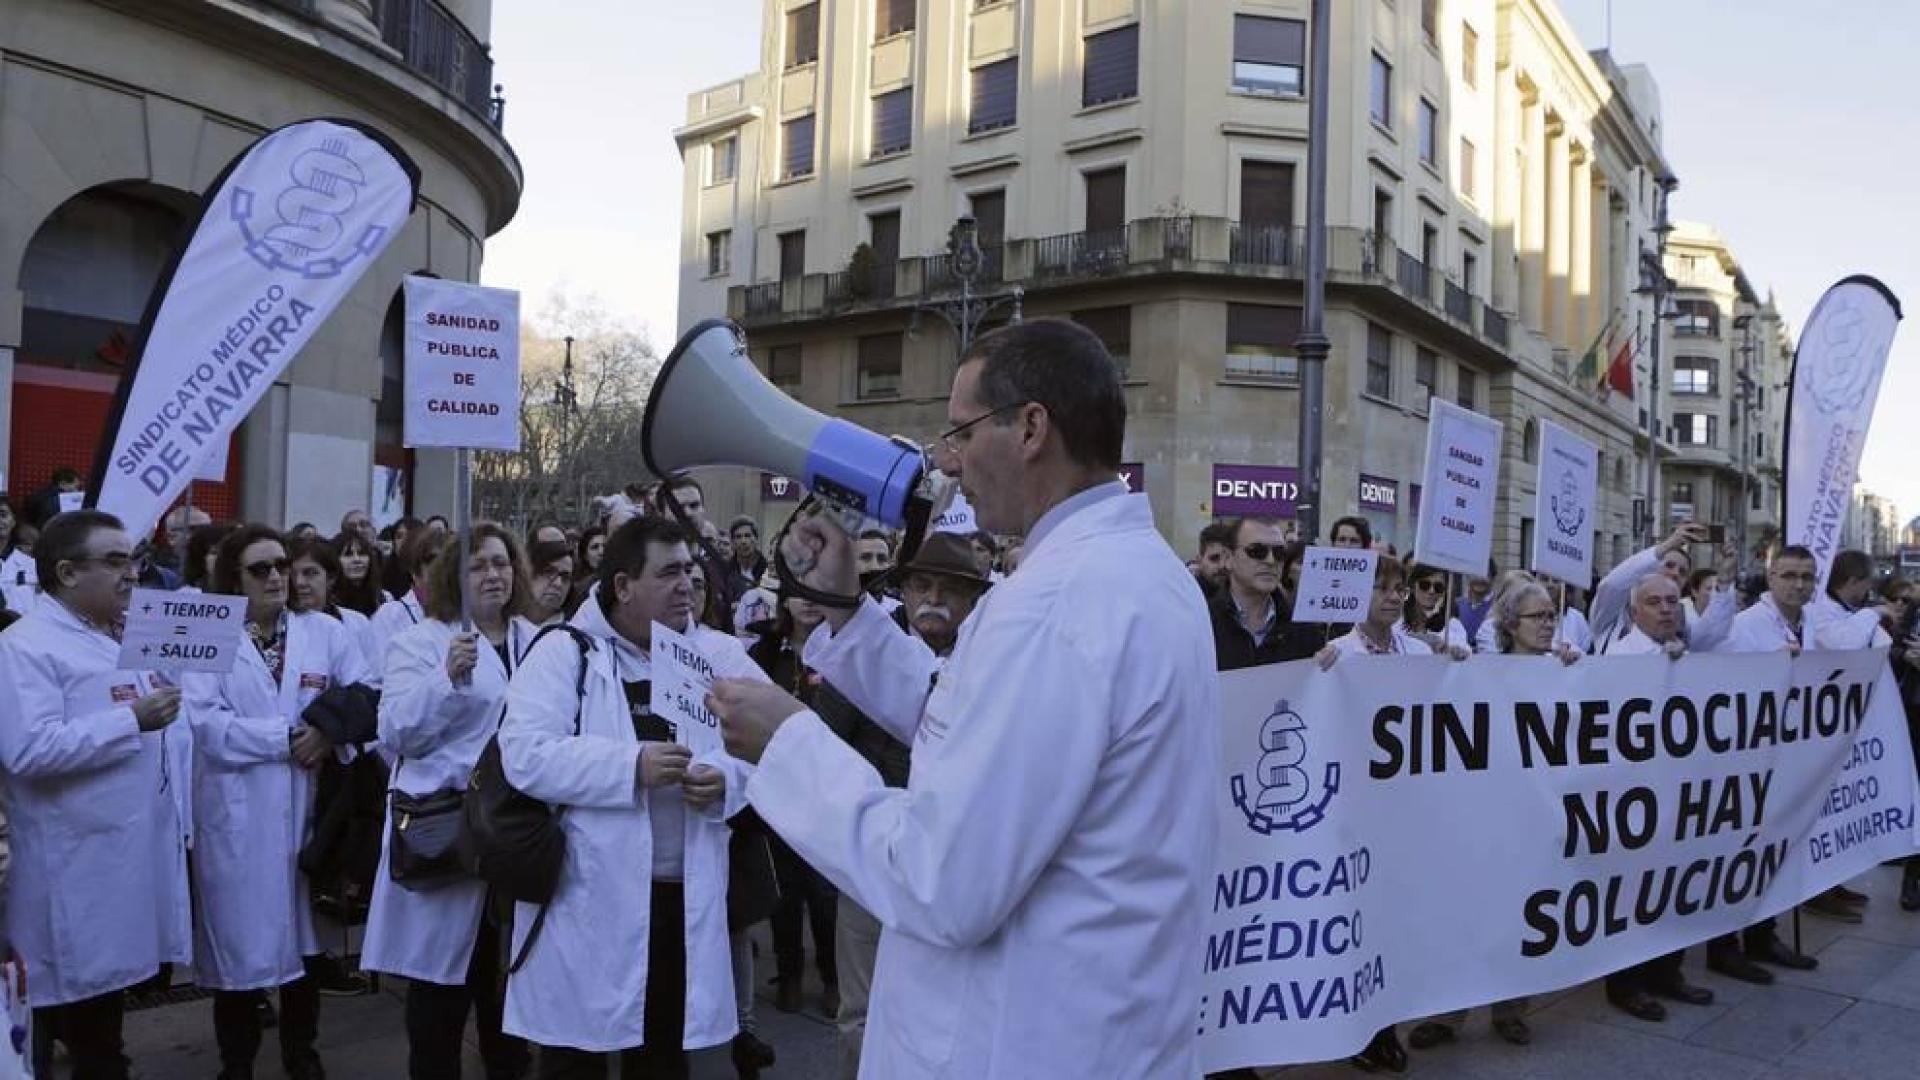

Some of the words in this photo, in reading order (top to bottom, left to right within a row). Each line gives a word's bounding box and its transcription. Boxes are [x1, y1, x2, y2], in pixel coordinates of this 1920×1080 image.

[426, 312, 500, 332] SANIDAD
[116, 362, 214, 475] SINDICATO
[212, 284, 284, 365] MÉDICO
[453, 372, 475, 386] DE
[139, 440, 190, 497] DE
[181, 297, 315, 446] NAVARRA
[427, 399, 500, 416] CALIDAD
[1361, 482, 1395, 504] DENTIX
[1324, 557, 1368, 572] TIEMPO
[141, 603, 153, 615] +
[162, 602, 230, 619] TIEMPO
[1321, 595, 1358, 610] SALUD
[175, 625, 187, 635] =
[158, 643, 218, 660] SALUD
[677, 694, 717, 728] SALUD
[1369, 702, 1490, 780] SIN
[1514, 669, 1874, 768] NEGOCIACIÓN
[1562, 786, 1659, 859] NO
[1675, 768, 1774, 842] HAY
[1809, 831, 1832, 863] DE
[1213, 846, 1370, 913] NDICATO
[1520, 833, 1788, 957] SOLUCIÓN
[1204, 909, 1362, 974] MÉDICO
[1218, 954, 1384, 1028] NAVARRA
